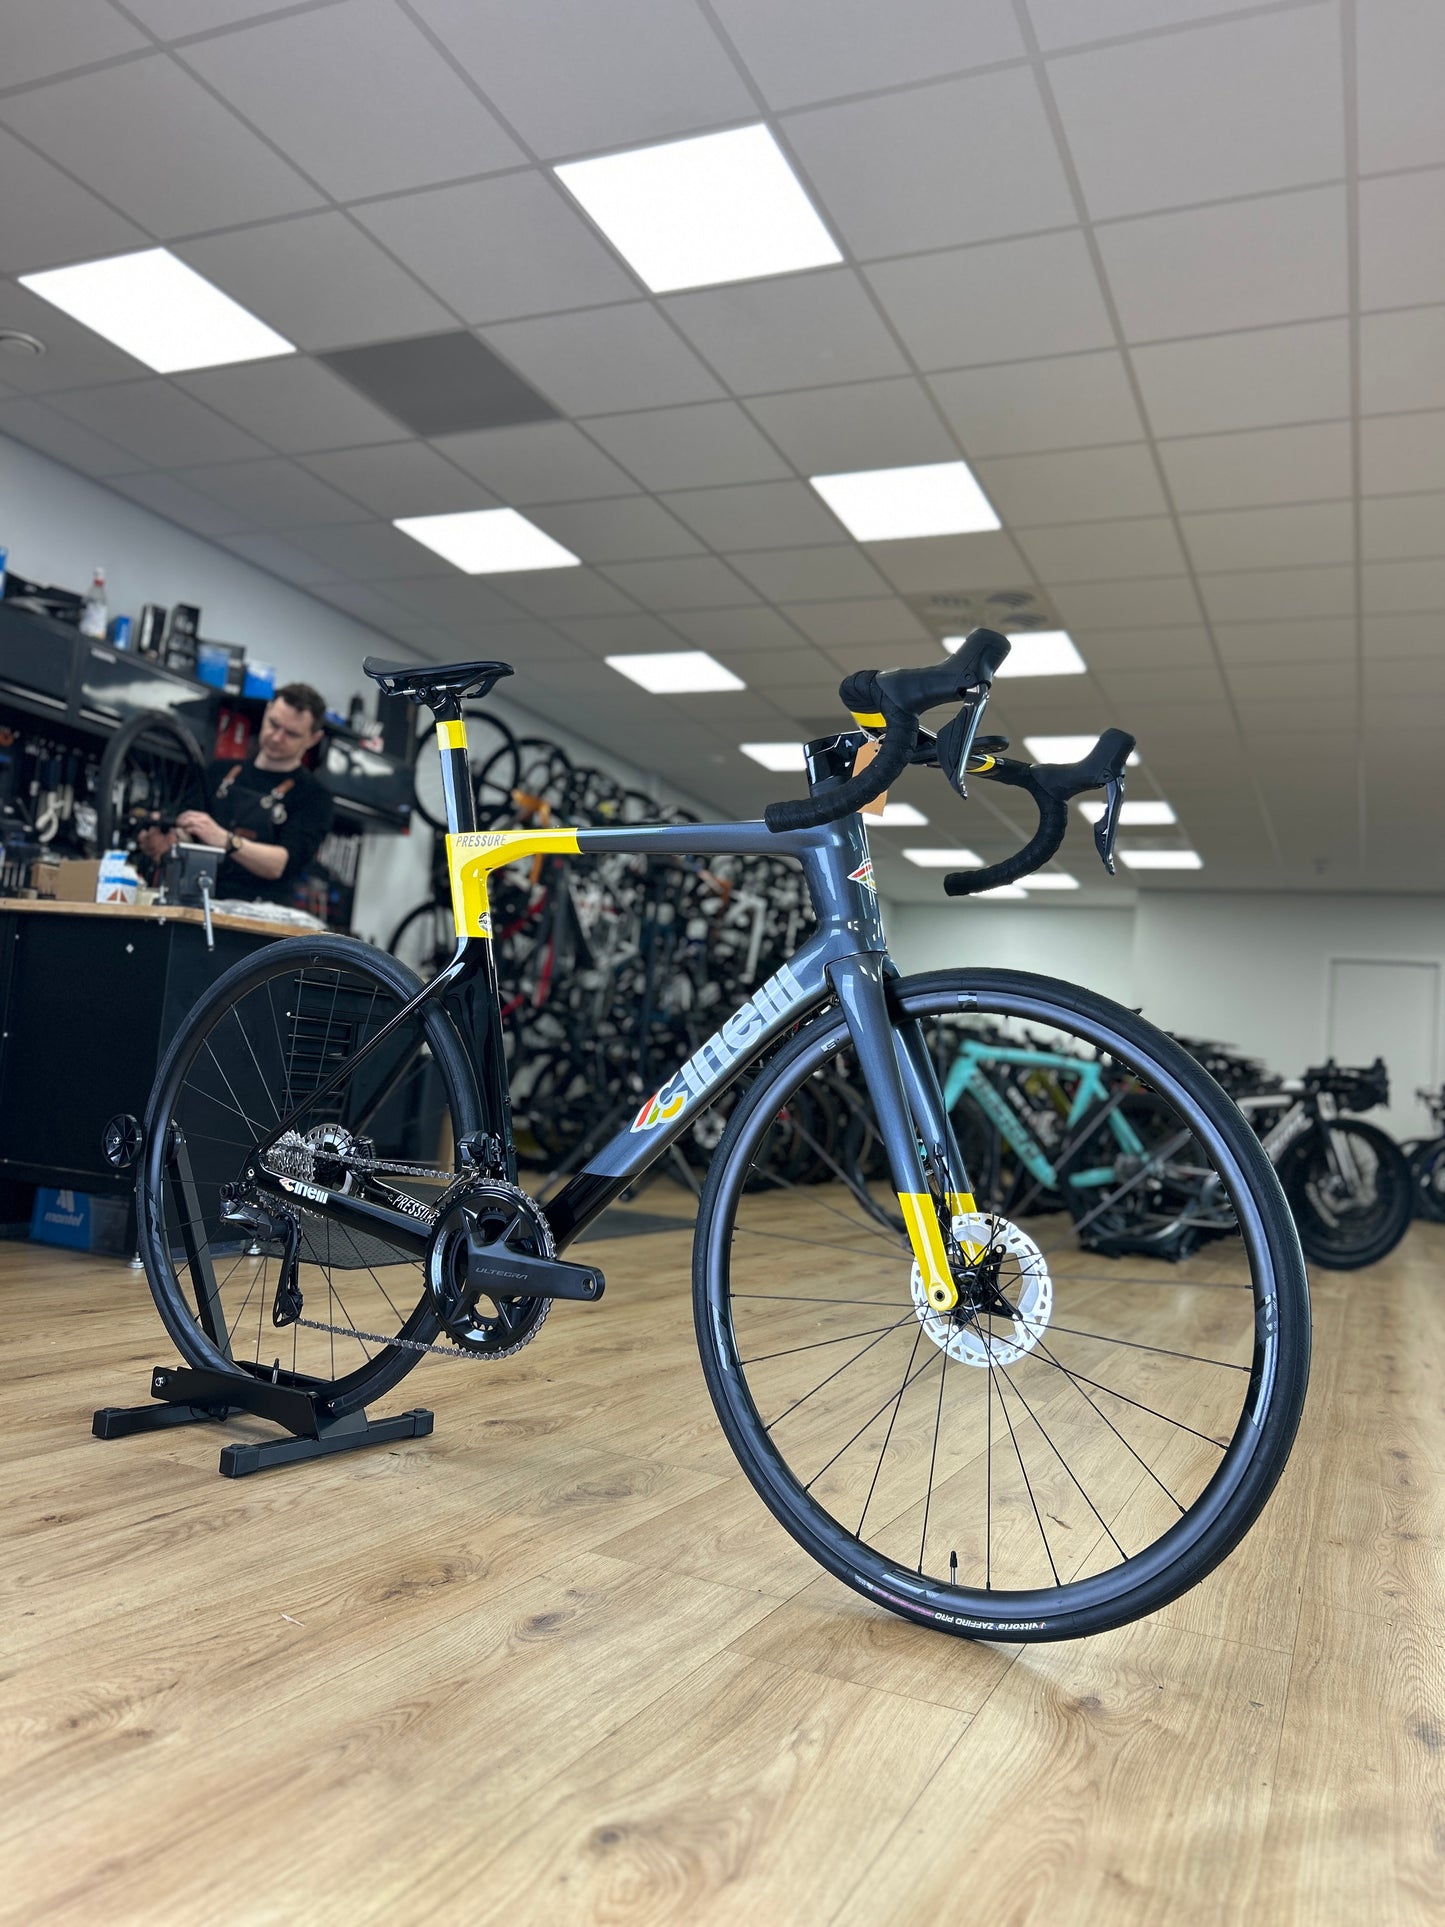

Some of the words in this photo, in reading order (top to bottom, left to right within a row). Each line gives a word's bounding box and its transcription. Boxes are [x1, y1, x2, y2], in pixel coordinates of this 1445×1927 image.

[456, 834, 508, 848] PRESSURE
[475, 1267, 528, 1280] ULTEGRA
[934, 1612, 954, 1623] PRO
[955, 1617, 994, 1630] ZAFFIRO
